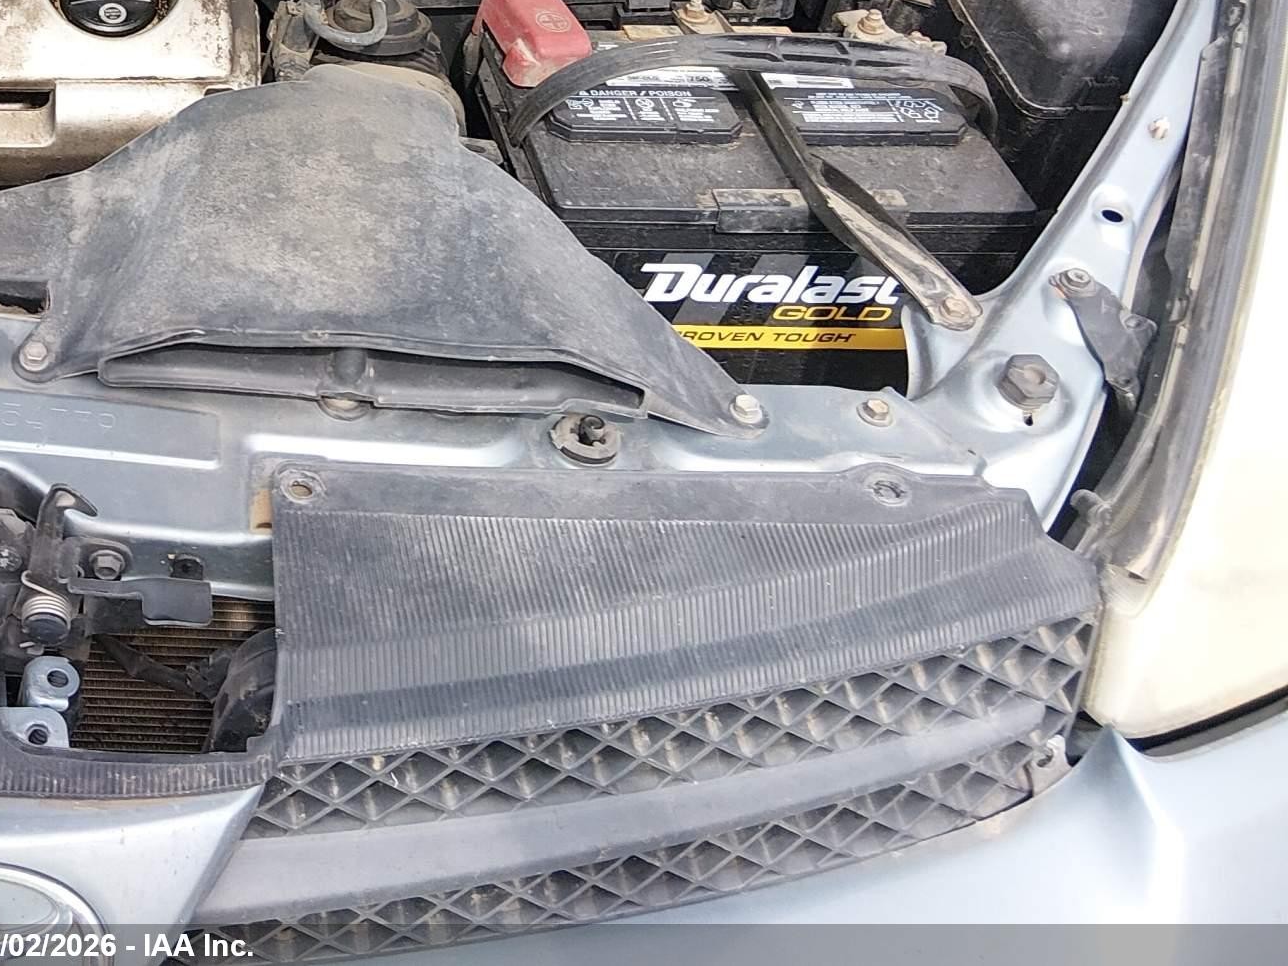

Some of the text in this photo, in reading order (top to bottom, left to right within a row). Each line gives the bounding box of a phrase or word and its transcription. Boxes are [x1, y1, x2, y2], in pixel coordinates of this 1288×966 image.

[590, 89, 637, 97] DANGER
[640, 263, 900, 304] Duralast
[772, 305, 892, 321] GOLD
[678, 330, 853, 343] ROVEN TOUGH
